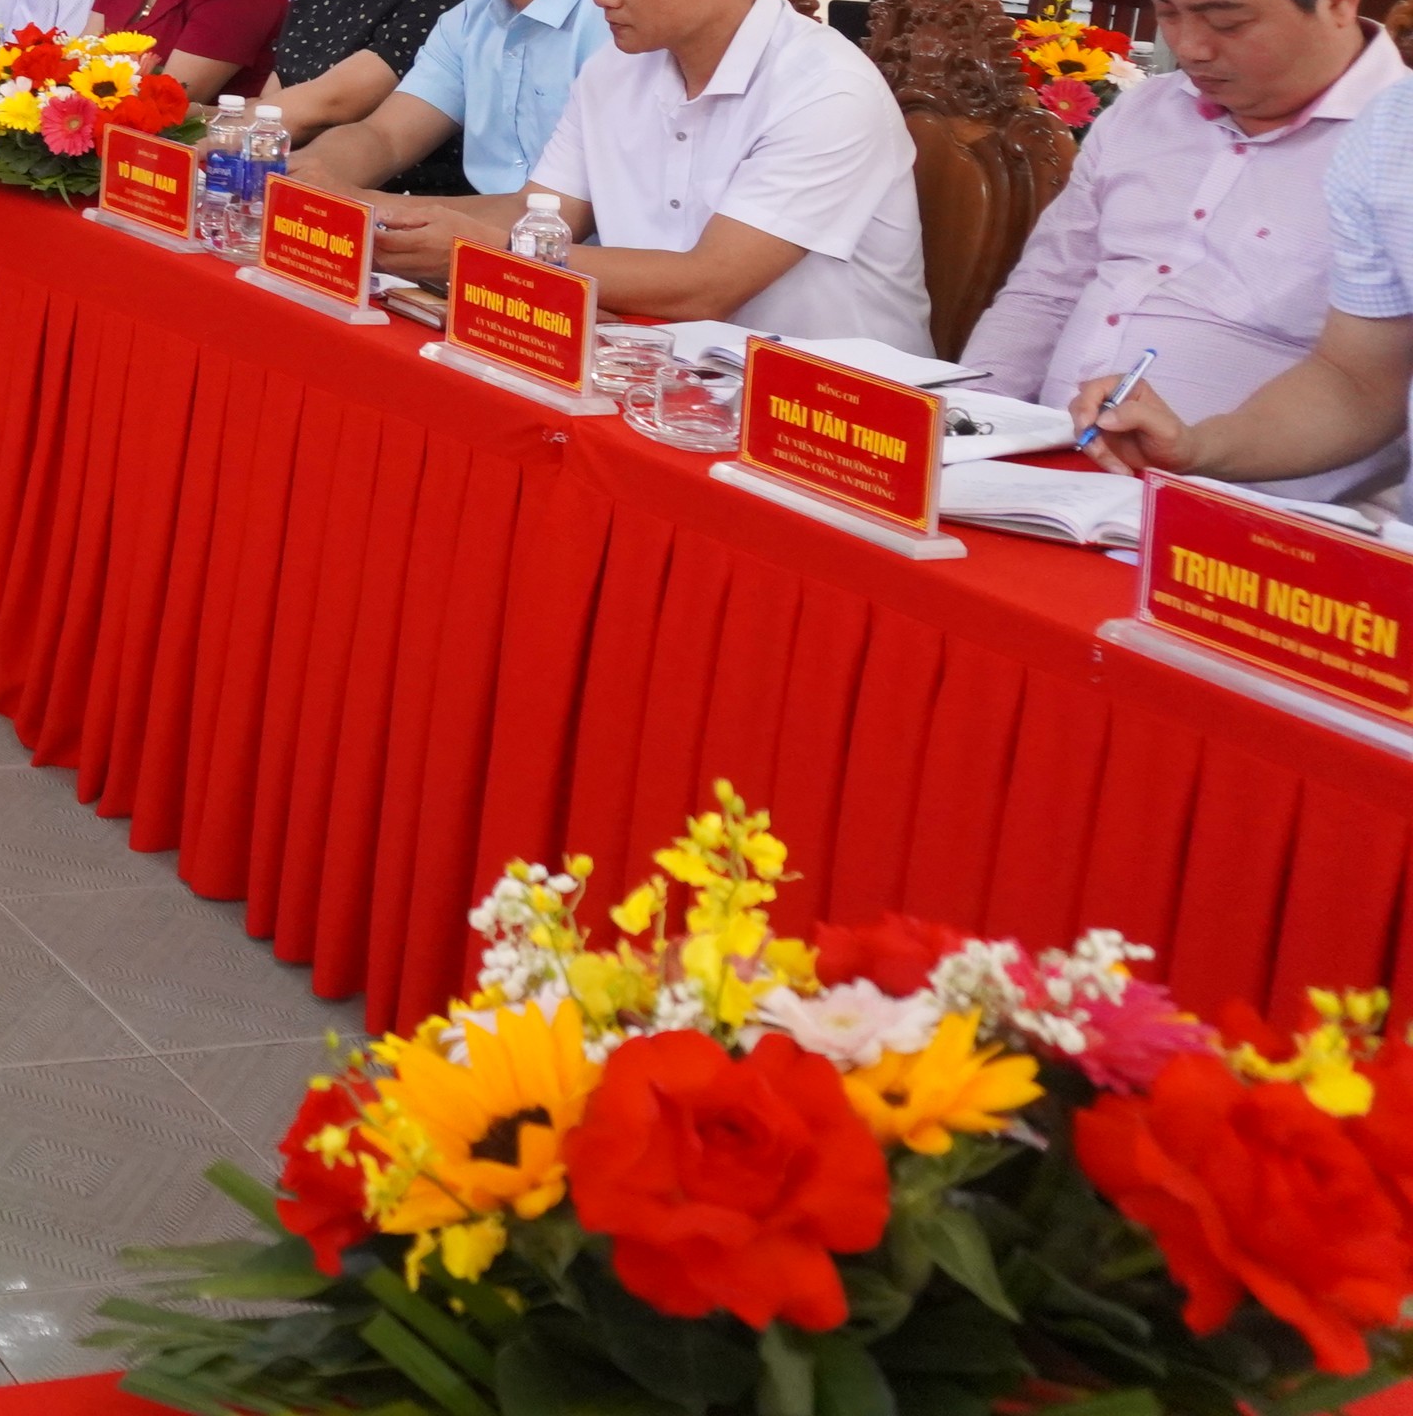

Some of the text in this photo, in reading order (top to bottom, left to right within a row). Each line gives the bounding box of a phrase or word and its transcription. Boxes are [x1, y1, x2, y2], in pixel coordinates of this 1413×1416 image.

[274, 217, 354, 258] NGUYỄN HỮU QUỐC
[465, 283, 571, 338] HUỲNH ĐỨC NGHĨA
[769, 395, 907, 464] THÁI VĂN THỊNH
[1170, 544, 1260, 610] TRỊNH
[1266, 578, 1399, 659] NGUYỆN
